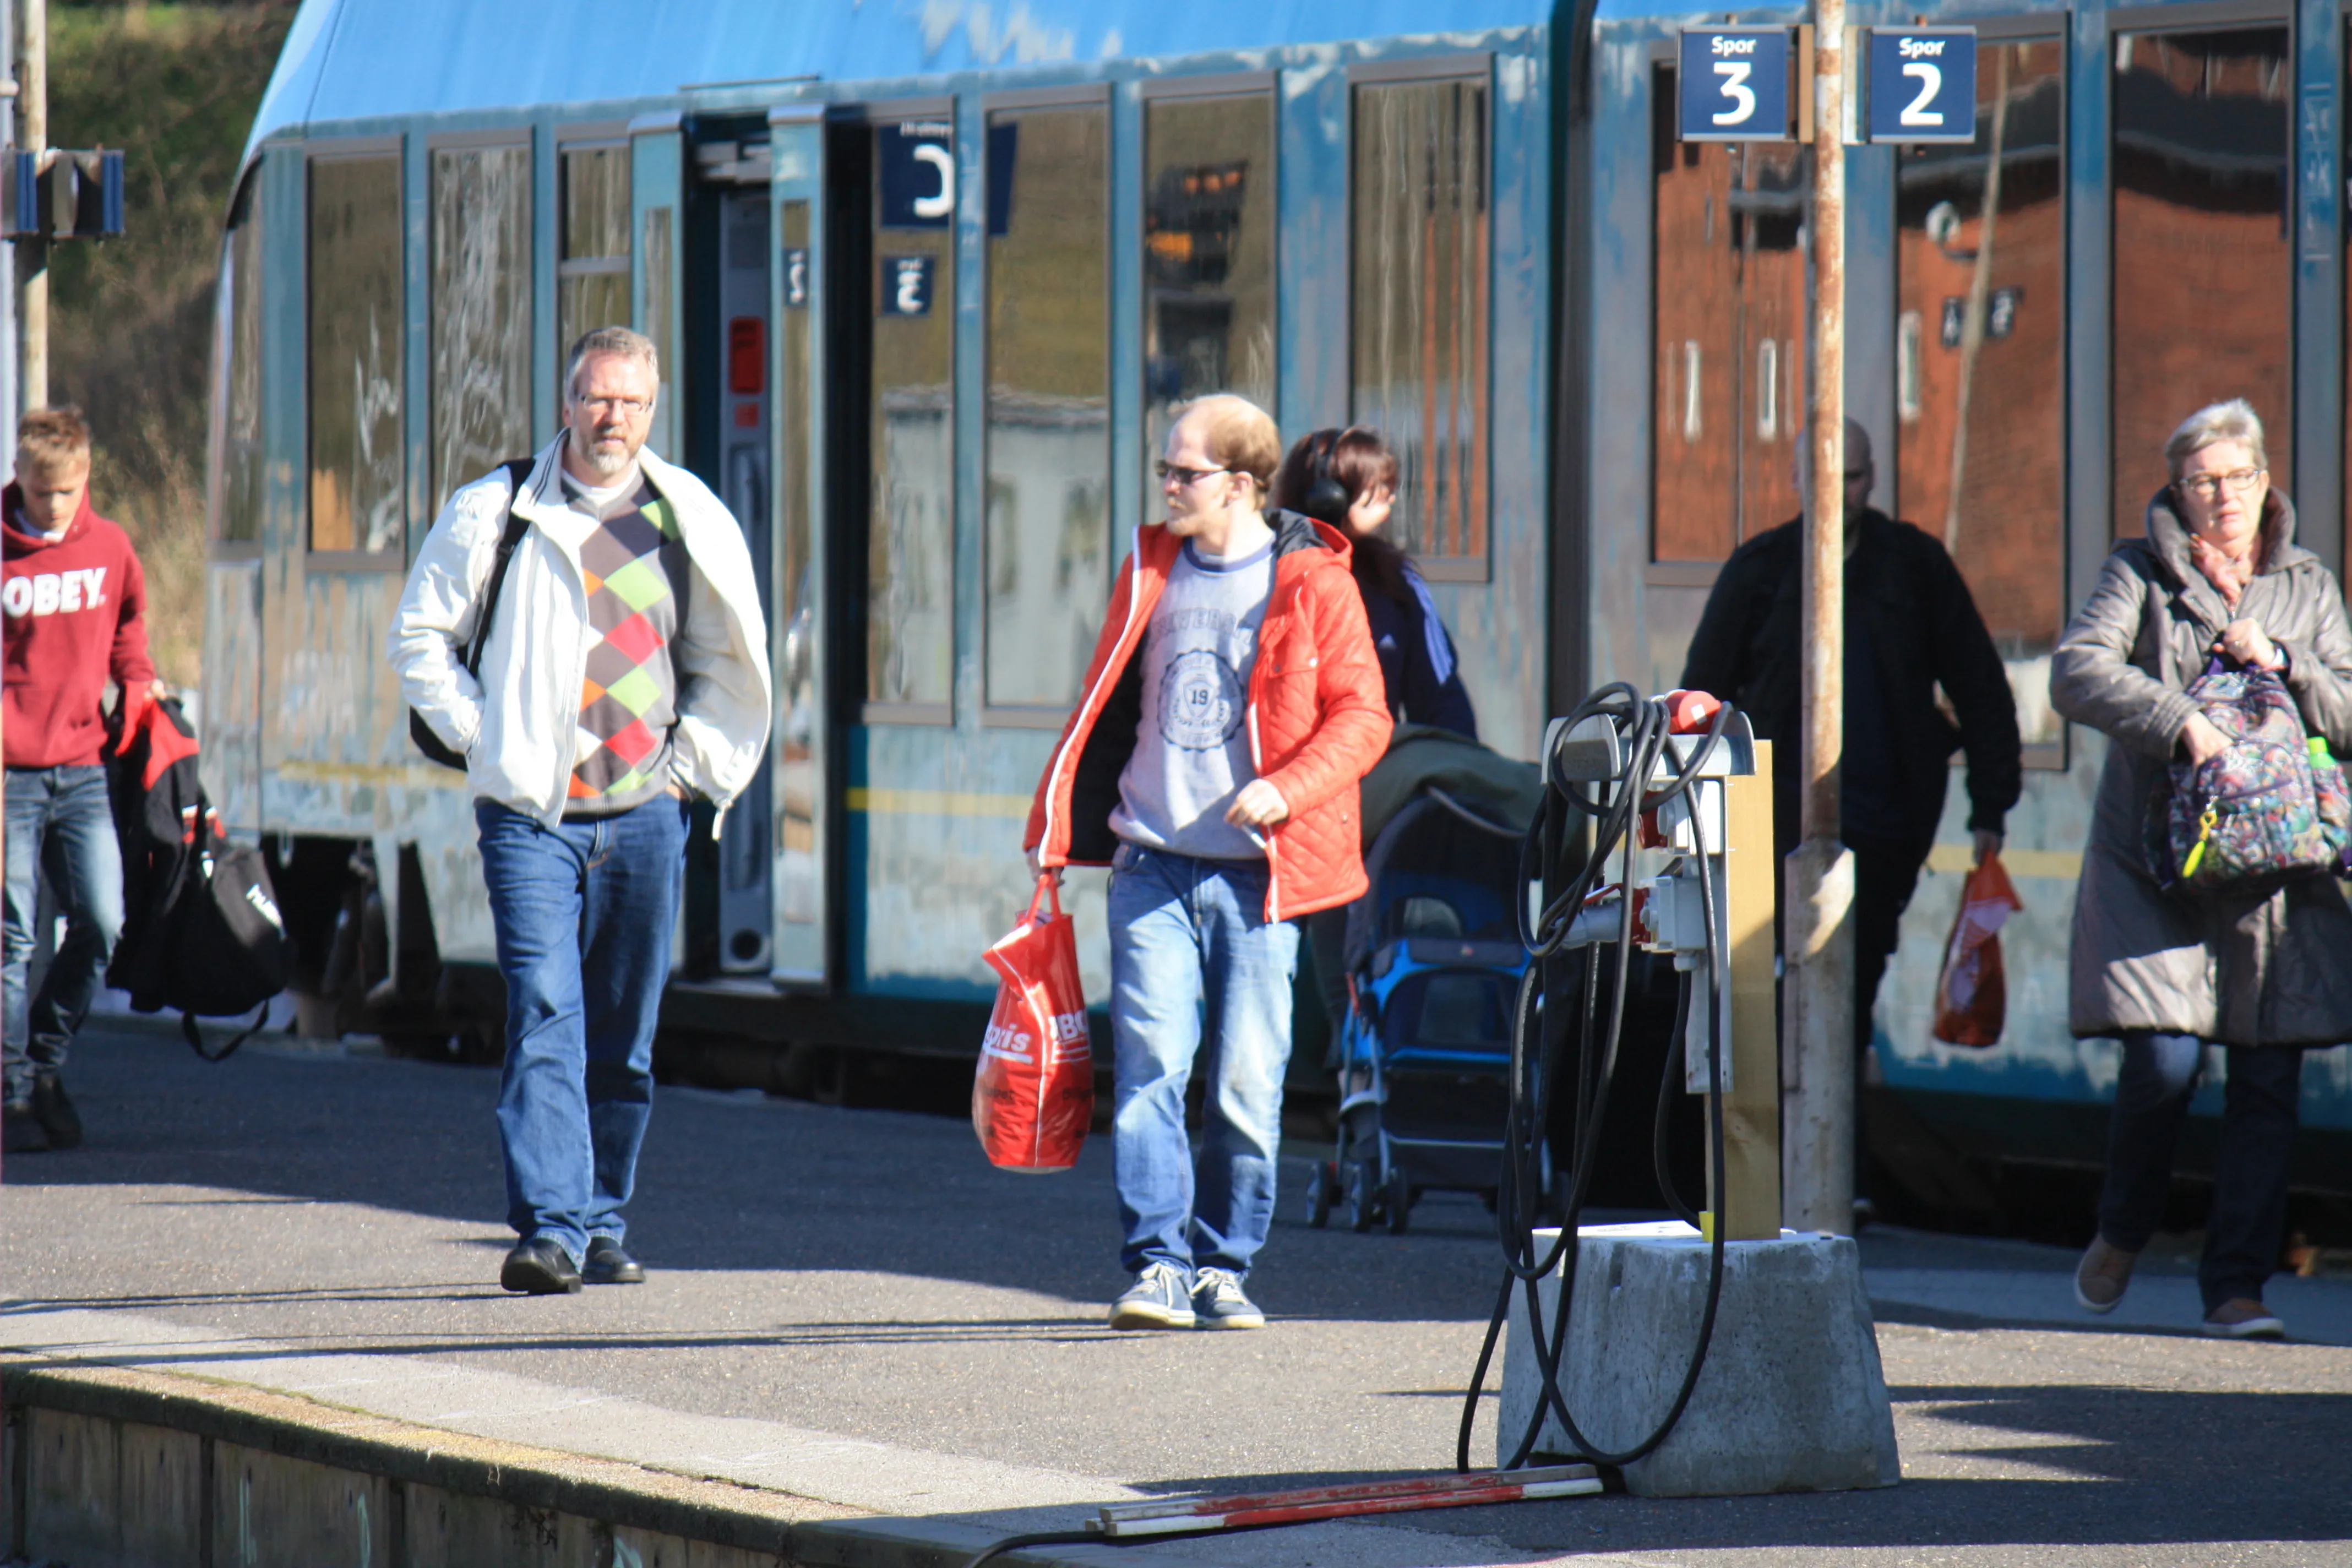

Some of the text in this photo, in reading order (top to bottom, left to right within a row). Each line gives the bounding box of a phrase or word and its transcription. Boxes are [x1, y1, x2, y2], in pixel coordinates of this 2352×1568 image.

[1711, 36, 1757, 57] Spor
[1899, 37, 1945, 58] Spor
[1712, 61, 1756, 126] 3
[1900, 62, 1944, 126] 2
[1191, 689, 1208, 705] 19
